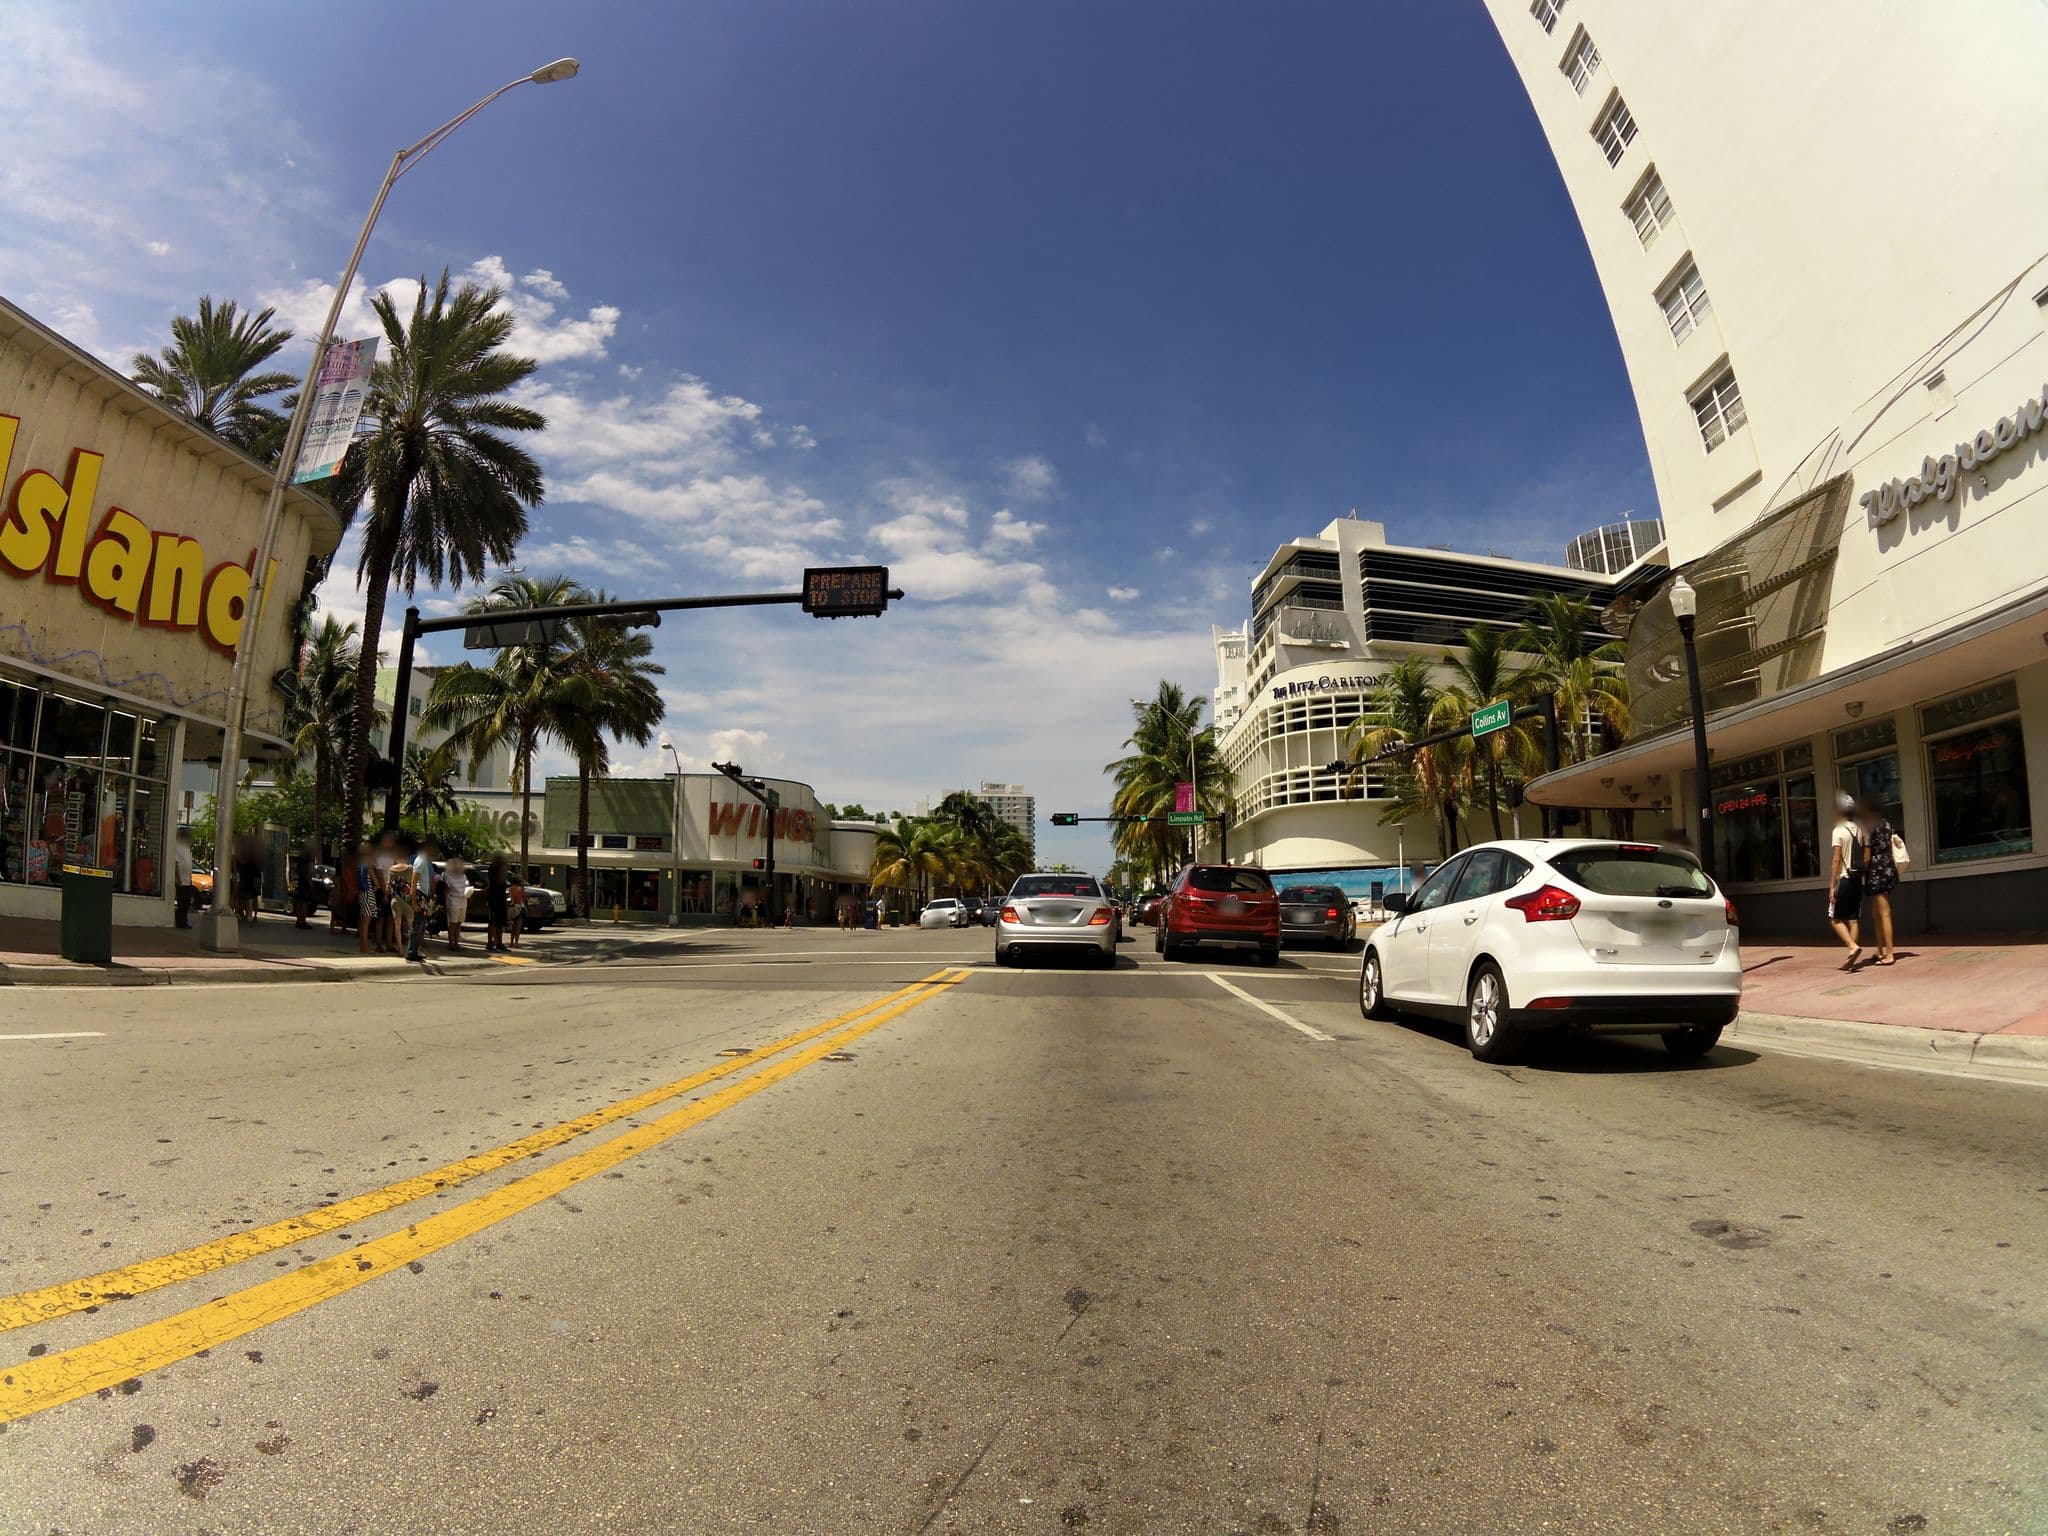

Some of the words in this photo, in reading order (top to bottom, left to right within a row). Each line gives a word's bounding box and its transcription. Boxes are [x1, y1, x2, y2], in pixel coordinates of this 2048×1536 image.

[310, 416, 355, 428] CELEBRATING
[326, 423, 353, 434] YEARS
[1860, 383, 2048, 533] Walgreen
[810, 573, 880, 589] PREPARE
[810, 590, 828, 606] TO
[841, 589, 879, 605] STOP
[1288, 675, 1385, 695] RITZ-CARLTON
[1475, 713, 1495, 729] Collins
[1497, 710, 1506, 721] Av
[1719, 800, 1739, 815] OPEN
[709, 802, 817, 843] WINGS
